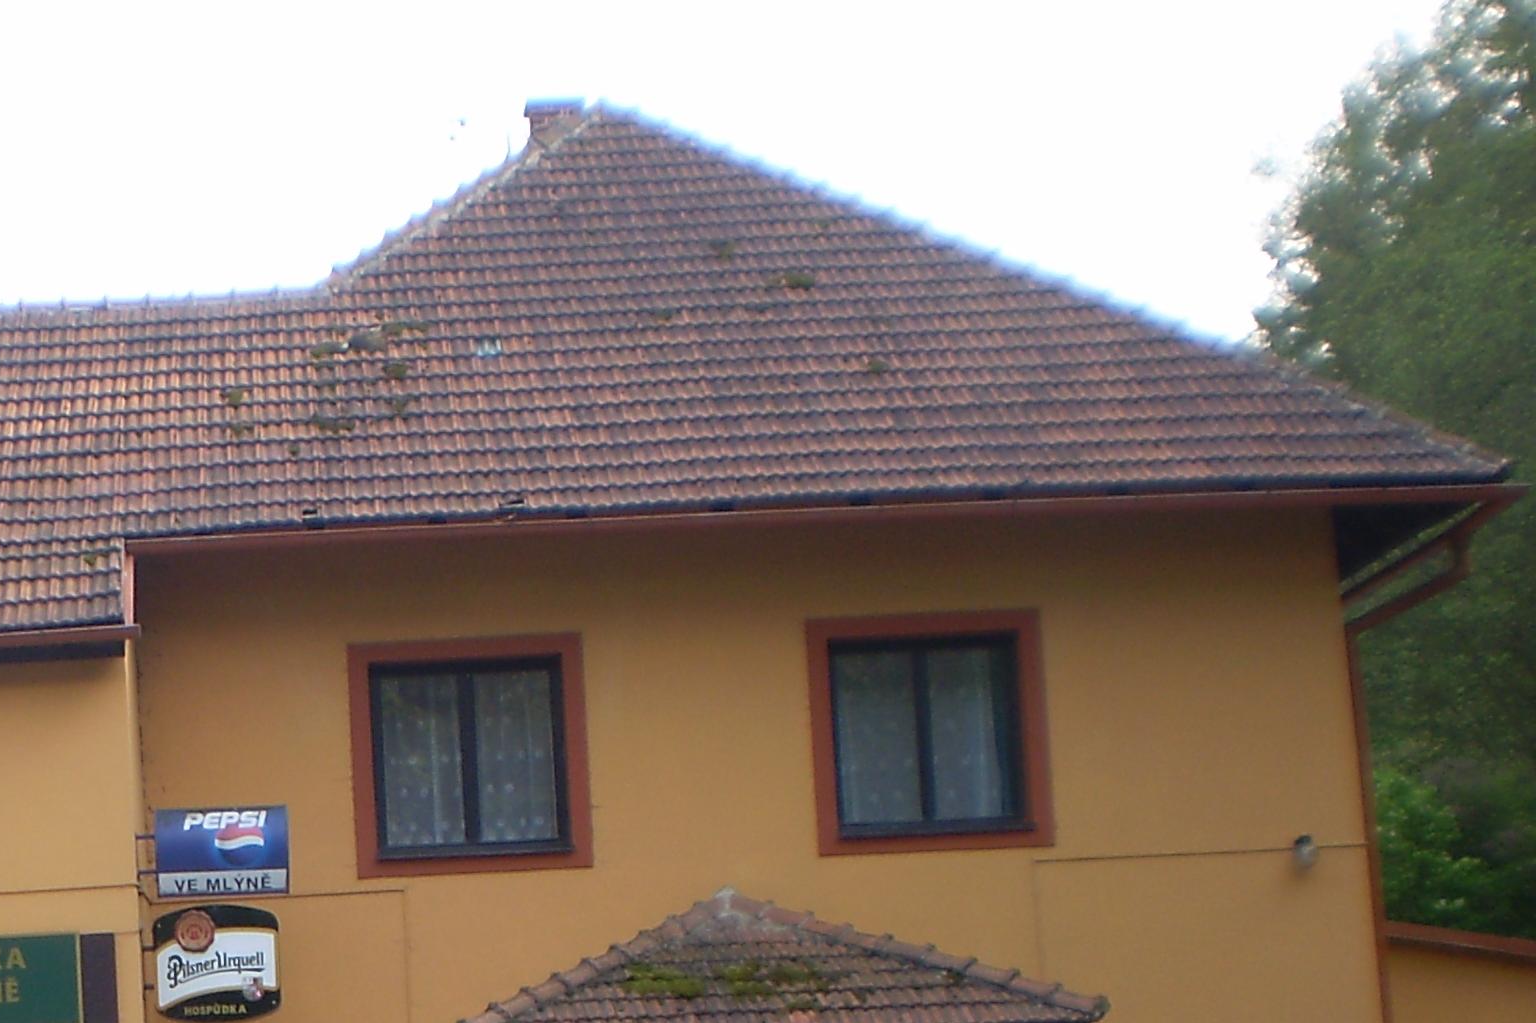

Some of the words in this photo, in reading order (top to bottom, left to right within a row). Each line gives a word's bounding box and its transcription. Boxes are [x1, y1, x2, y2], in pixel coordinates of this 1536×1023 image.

[184, 810, 266, 830] PEPSI
[174, 878, 198, 892] VE
[206, 873, 272, 891] MLÝNĚ
[167, 954, 216, 988] Pilsner
[215, 951, 264, 974] Urquell
[184, 1002, 248, 1016] HOSPŮDKA
